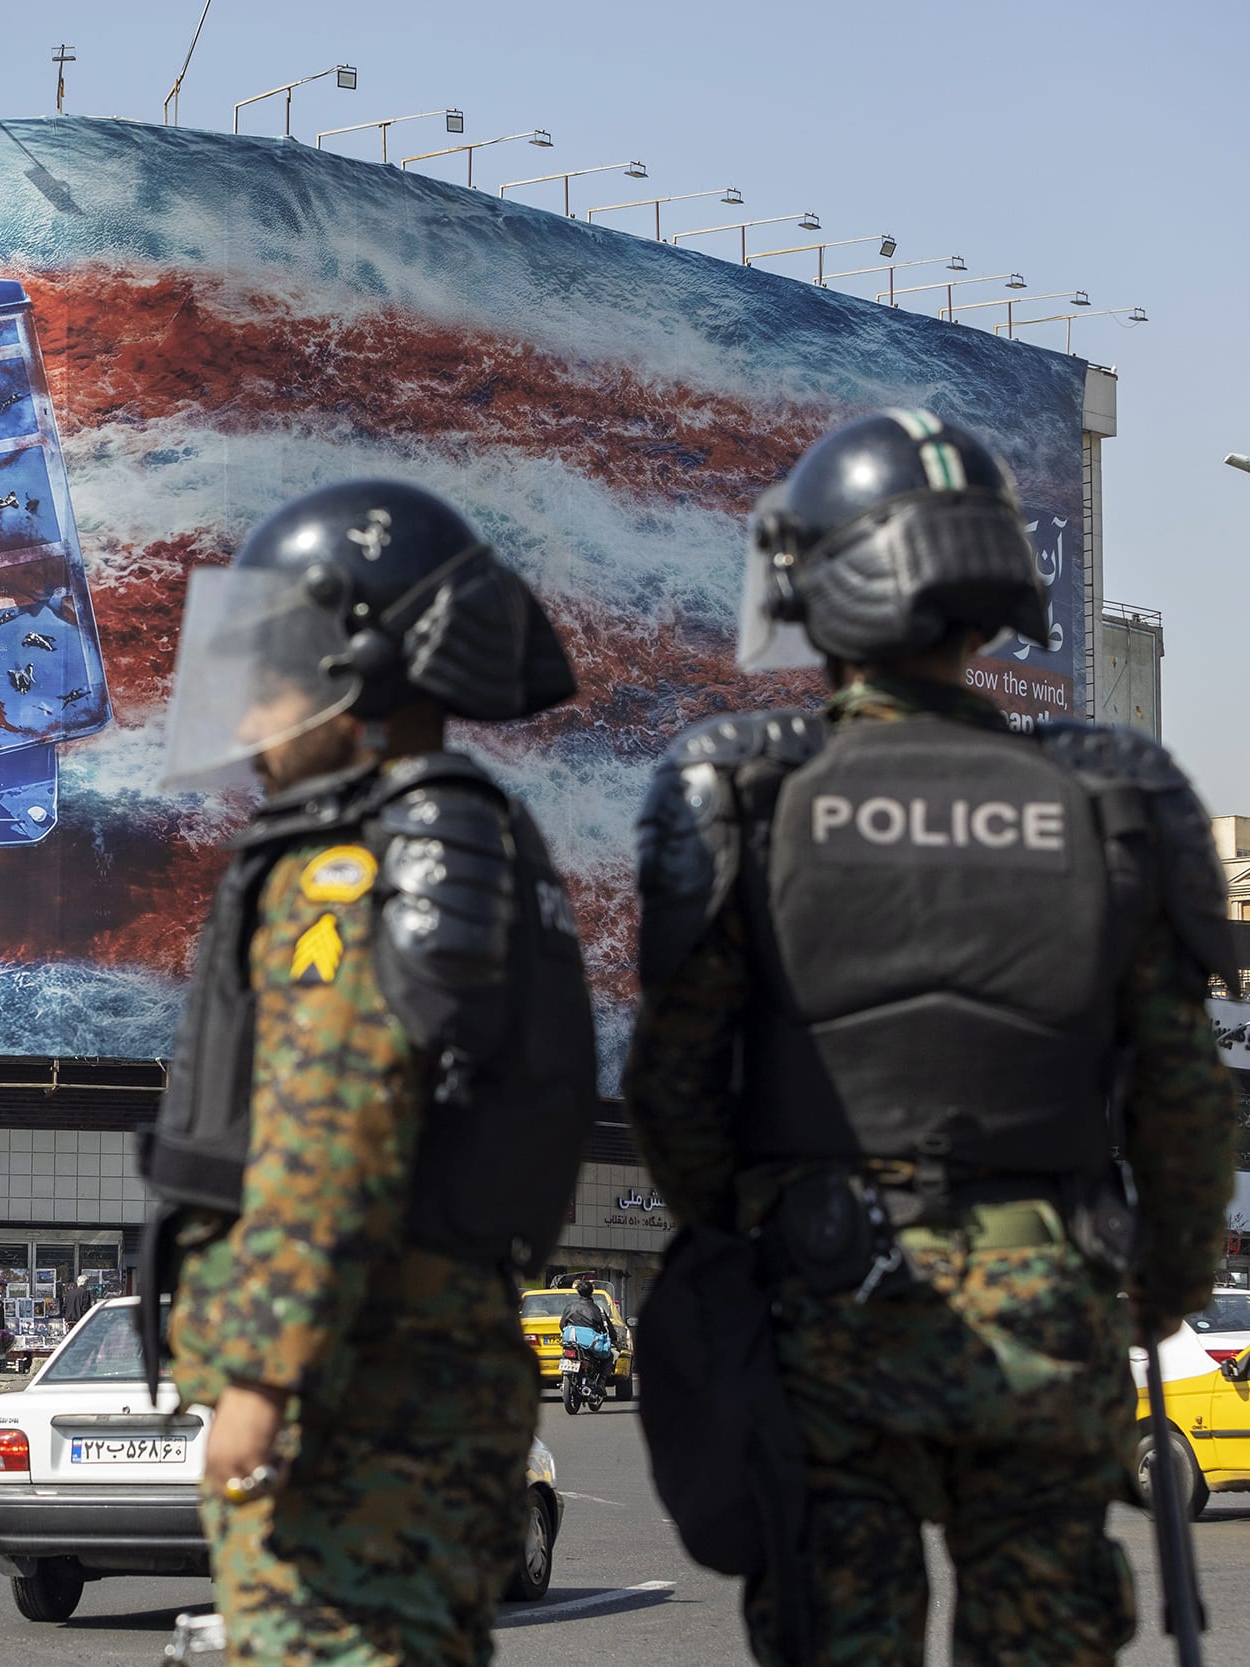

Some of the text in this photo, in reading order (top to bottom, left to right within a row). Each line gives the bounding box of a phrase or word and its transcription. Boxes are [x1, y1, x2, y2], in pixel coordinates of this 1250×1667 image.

[965, 668, 1068, 711] sow the wind,
[812, 795, 1065, 849] POLICE
[619, 1188, 643, 1210] ملی
[604, 1214, 627, 1228] انقلاب
